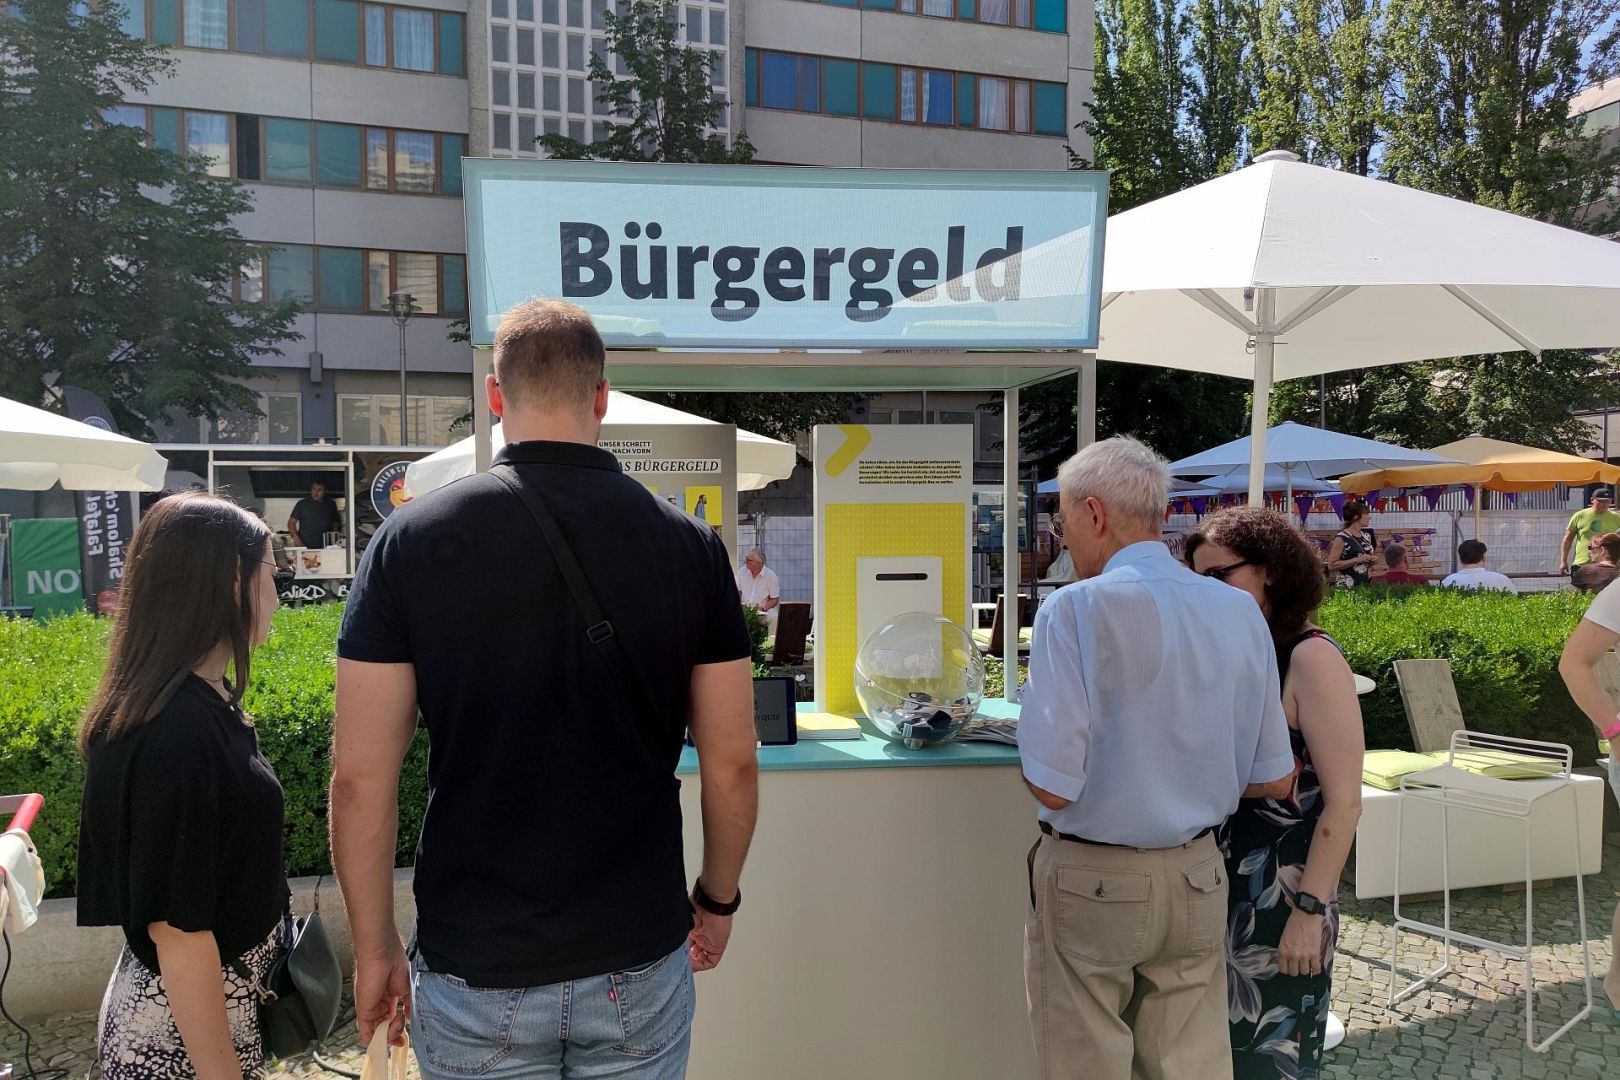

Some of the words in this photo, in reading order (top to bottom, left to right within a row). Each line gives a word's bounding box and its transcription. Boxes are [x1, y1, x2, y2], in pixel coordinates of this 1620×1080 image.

[559, 221, 1024, 322] Bürgergeld
[634, 459, 719, 472] BÜRGERGELD
[27, 568, 81, 594] NO
